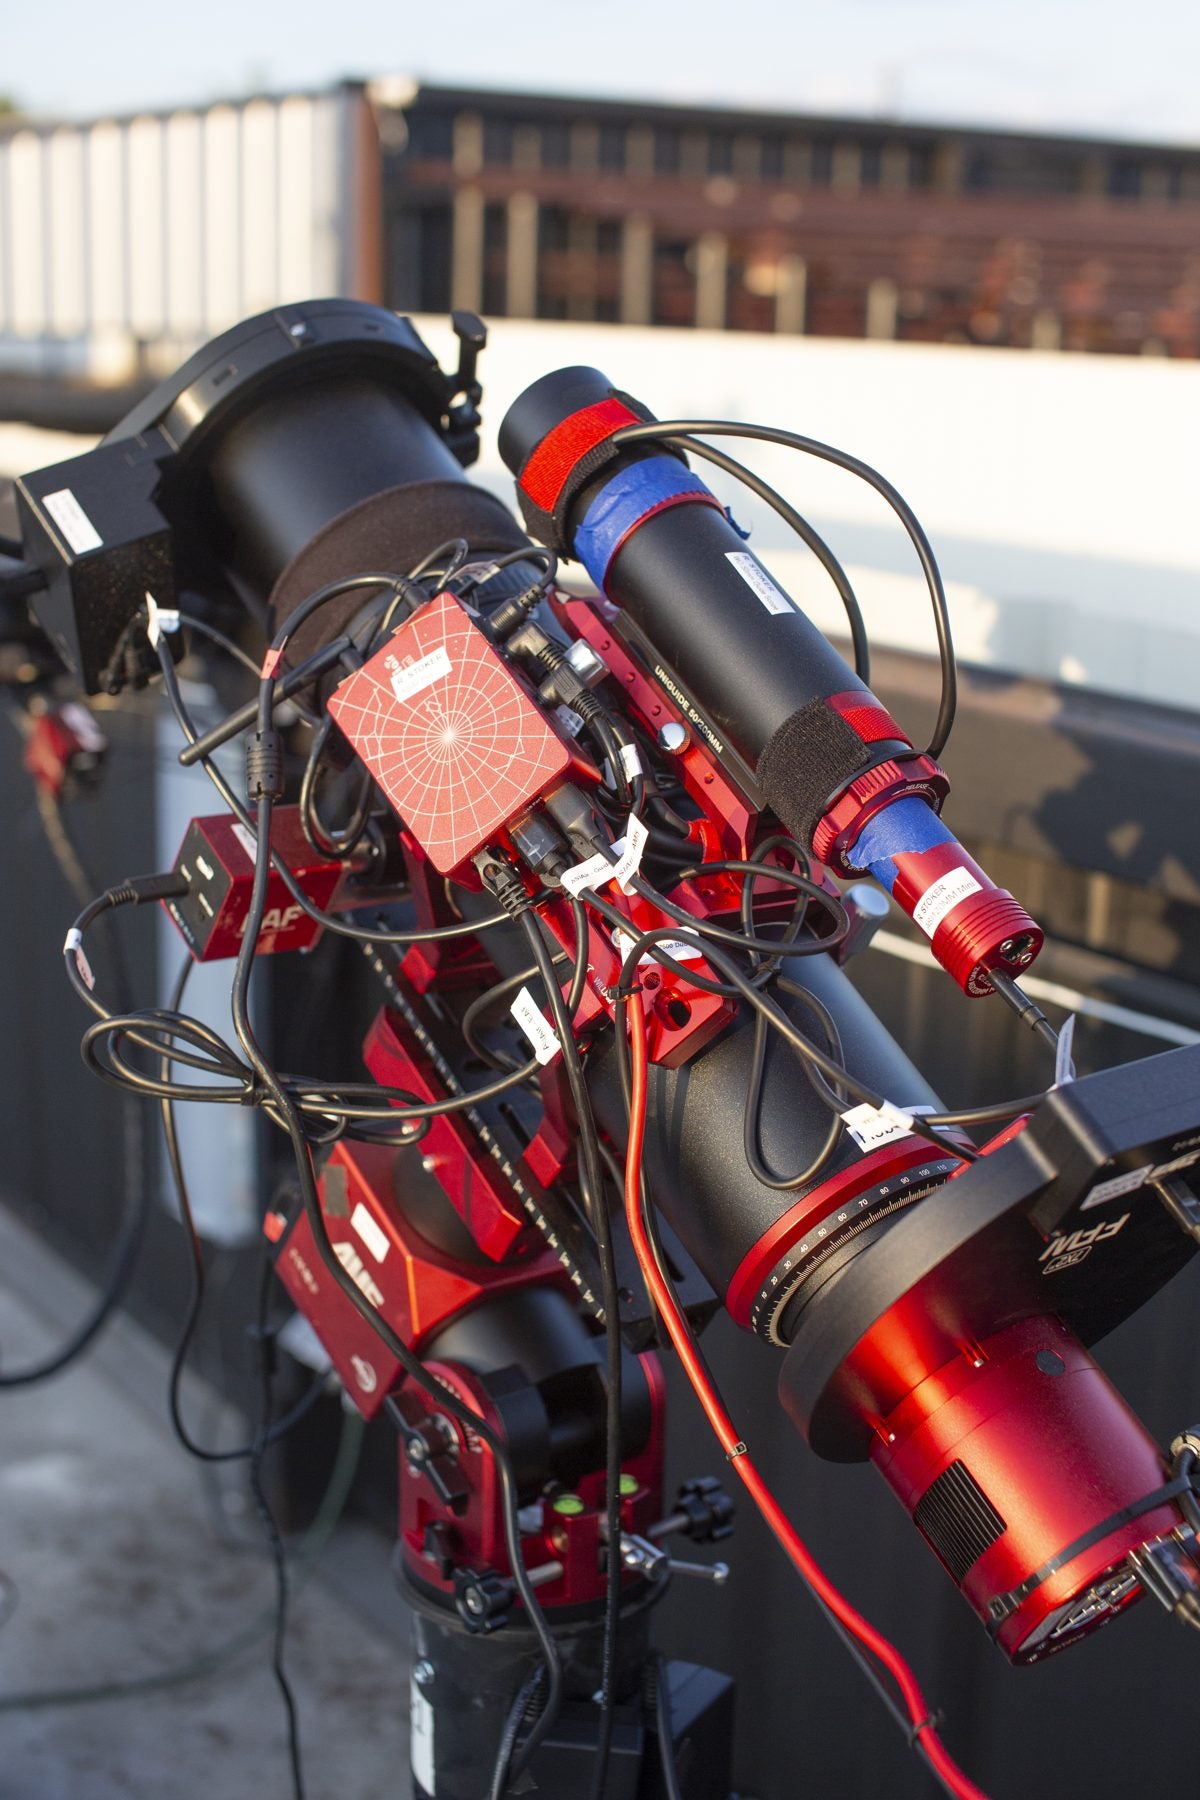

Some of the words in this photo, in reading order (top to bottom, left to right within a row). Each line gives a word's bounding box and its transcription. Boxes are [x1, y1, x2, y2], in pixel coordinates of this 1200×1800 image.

[750, 562, 776, 592] STOKER
[407, 653, 442, 679] STOKER
[655, 665, 690, 711] UNIGUIDE
[688, 708, 723, 754] 50/200MM
[921, 884, 947, 914] STOKER
[957, 880, 975, 894] Mini
[760, 1291, 769, 1299] 10
[769, 1275, 780, 1285] 20
[783, 1259, 793, 1269] 30
[798, 1243, 810, 1253] 40
[817, 1227, 828, 1237] 50
[837, 1212, 849, 1222] 60
[858, 1197, 870, 1208] 70
[879, 1185, 890, 1195] 80
[900, 1176, 910, 1185] 90
[918, 1168, 931, 1177] 100
[936, 1163, 947, 1171] 110
